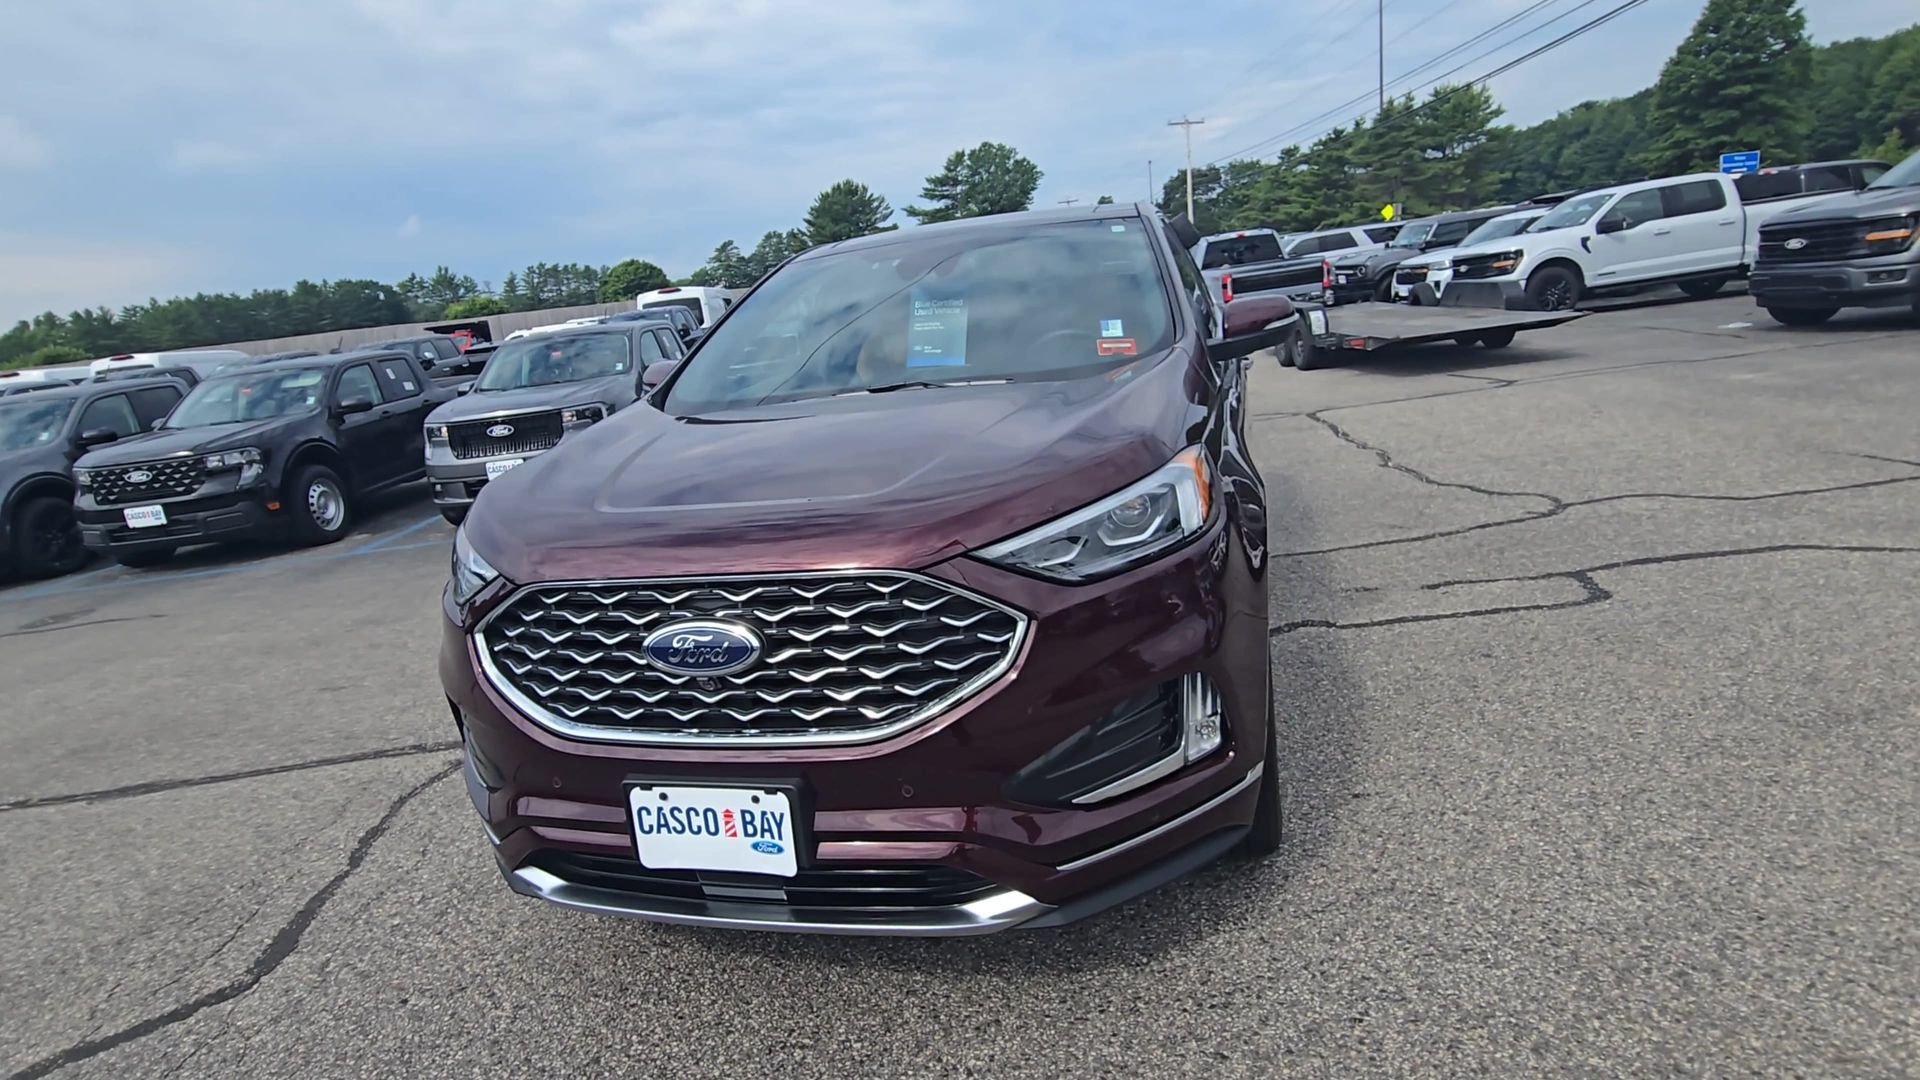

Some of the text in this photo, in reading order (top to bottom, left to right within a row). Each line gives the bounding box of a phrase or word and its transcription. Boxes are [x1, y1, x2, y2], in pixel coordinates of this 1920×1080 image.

[668, 634, 729, 664] Ford
[637, 805, 785, 841] CASCO BAY
[757, 841, 779, 855] Ford
